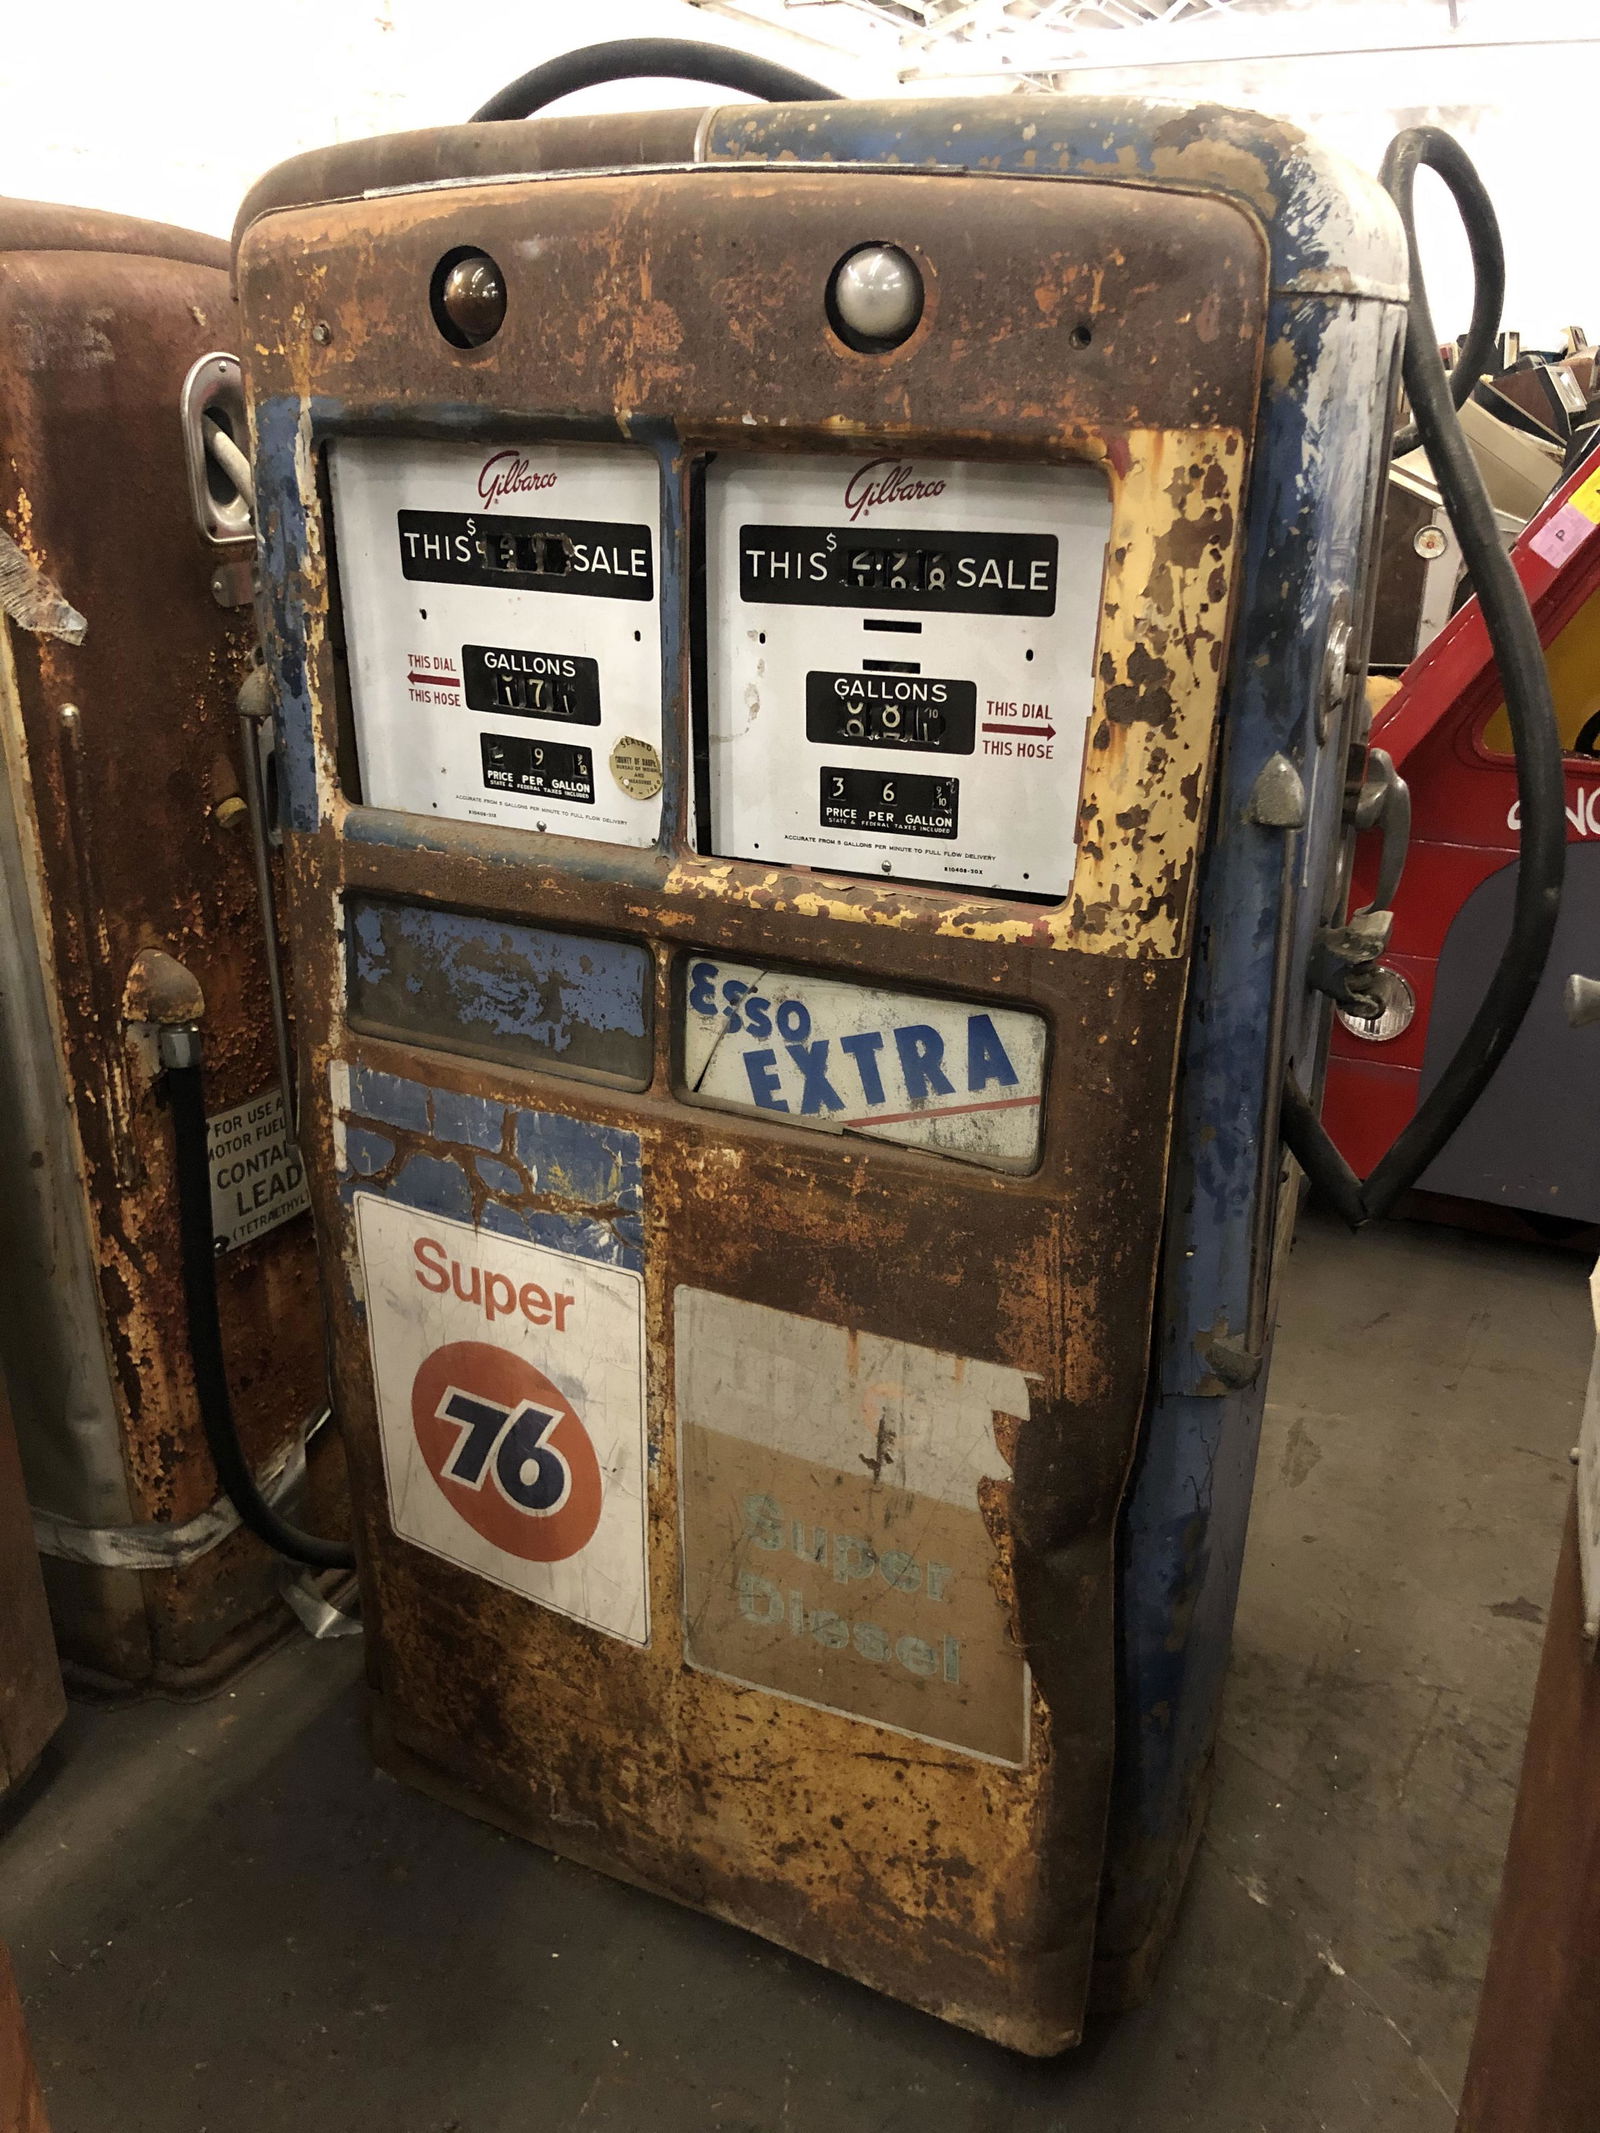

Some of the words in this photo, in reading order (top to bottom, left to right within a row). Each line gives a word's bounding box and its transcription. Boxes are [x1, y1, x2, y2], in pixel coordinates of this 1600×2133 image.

[478, 450, 557, 509] Gilbarco
[844, 456, 947, 521] Gilbarco
[403, 532, 472, 562] THIS
[466, 517, 477, 536] $
[573, 544, 648, 577] SALE
[745, 549, 828, 581] THIS
[825, 532, 837, 552] $
[956, 556, 1050, 591] SALE
[407, 654, 431, 670] THIS
[433, 656, 457, 672] DIAL
[484, 651, 576, 677] GALLONS
[408, 688, 431, 703] THIS
[433, 691, 461, 707] HOSE
[834, 678, 948, 703] GALLONS
[986, 700, 1019, 717] THIS
[1022, 703, 1053, 720] DIAL
[982, 740, 1012, 756] THIS
[1017, 743, 1054, 760] HOSE
[487, 769, 514, 782] PRICE
[521, 774, 544, 786] PER
[551, 778, 591, 794] GALLON
[490, 779, 506, 788] STATE
[516, 783, 541, 792] FEDERAL
[543, 787, 562, 795] TAXES
[564, 790, 590, 799] INCLUDED
[832, 776, 844, 797] 3
[882, 782, 895, 802] 6
[455, 794, 482, 803] ACCURATE
[483, 798, 498, 806] FROM
[504, 801, 528, 810] GALLONS
[541, 807, 560, 815] MINUTE
[585, 814, 601, 822] FLOW
[602, 817, 628, 825] DELIVERY
[826, 807, 857, 819] PRICE
[868, 811, 894, 822] PER
[905, 814, 952, 828] GALLON
[828, 817, 847, 825] STATE
[861, 821, 890, 829] FEDERAL
[920, 826, 950, 834] INCLUDED
[784, 834, 816, 843] ACCURATE
[843, 841, 872, 849] GALLONS
[889, 845, 912, 853] MINUTE
[964, 852, 996, 861] DELIVERY
[742, 1014, 1019, 1115] EXTRA
[214, 1115, 243, 1138] FOR
[247, 1102, 273, 1124] USE
[236, 1164, 304, 1217] LEAD
[413, 1236, 575, 1332] Super
[434, 1385, 572, 1518] 76
[742, 1494, 952, 1602] Super
[738, 1568, 960, 1685] Diesel
